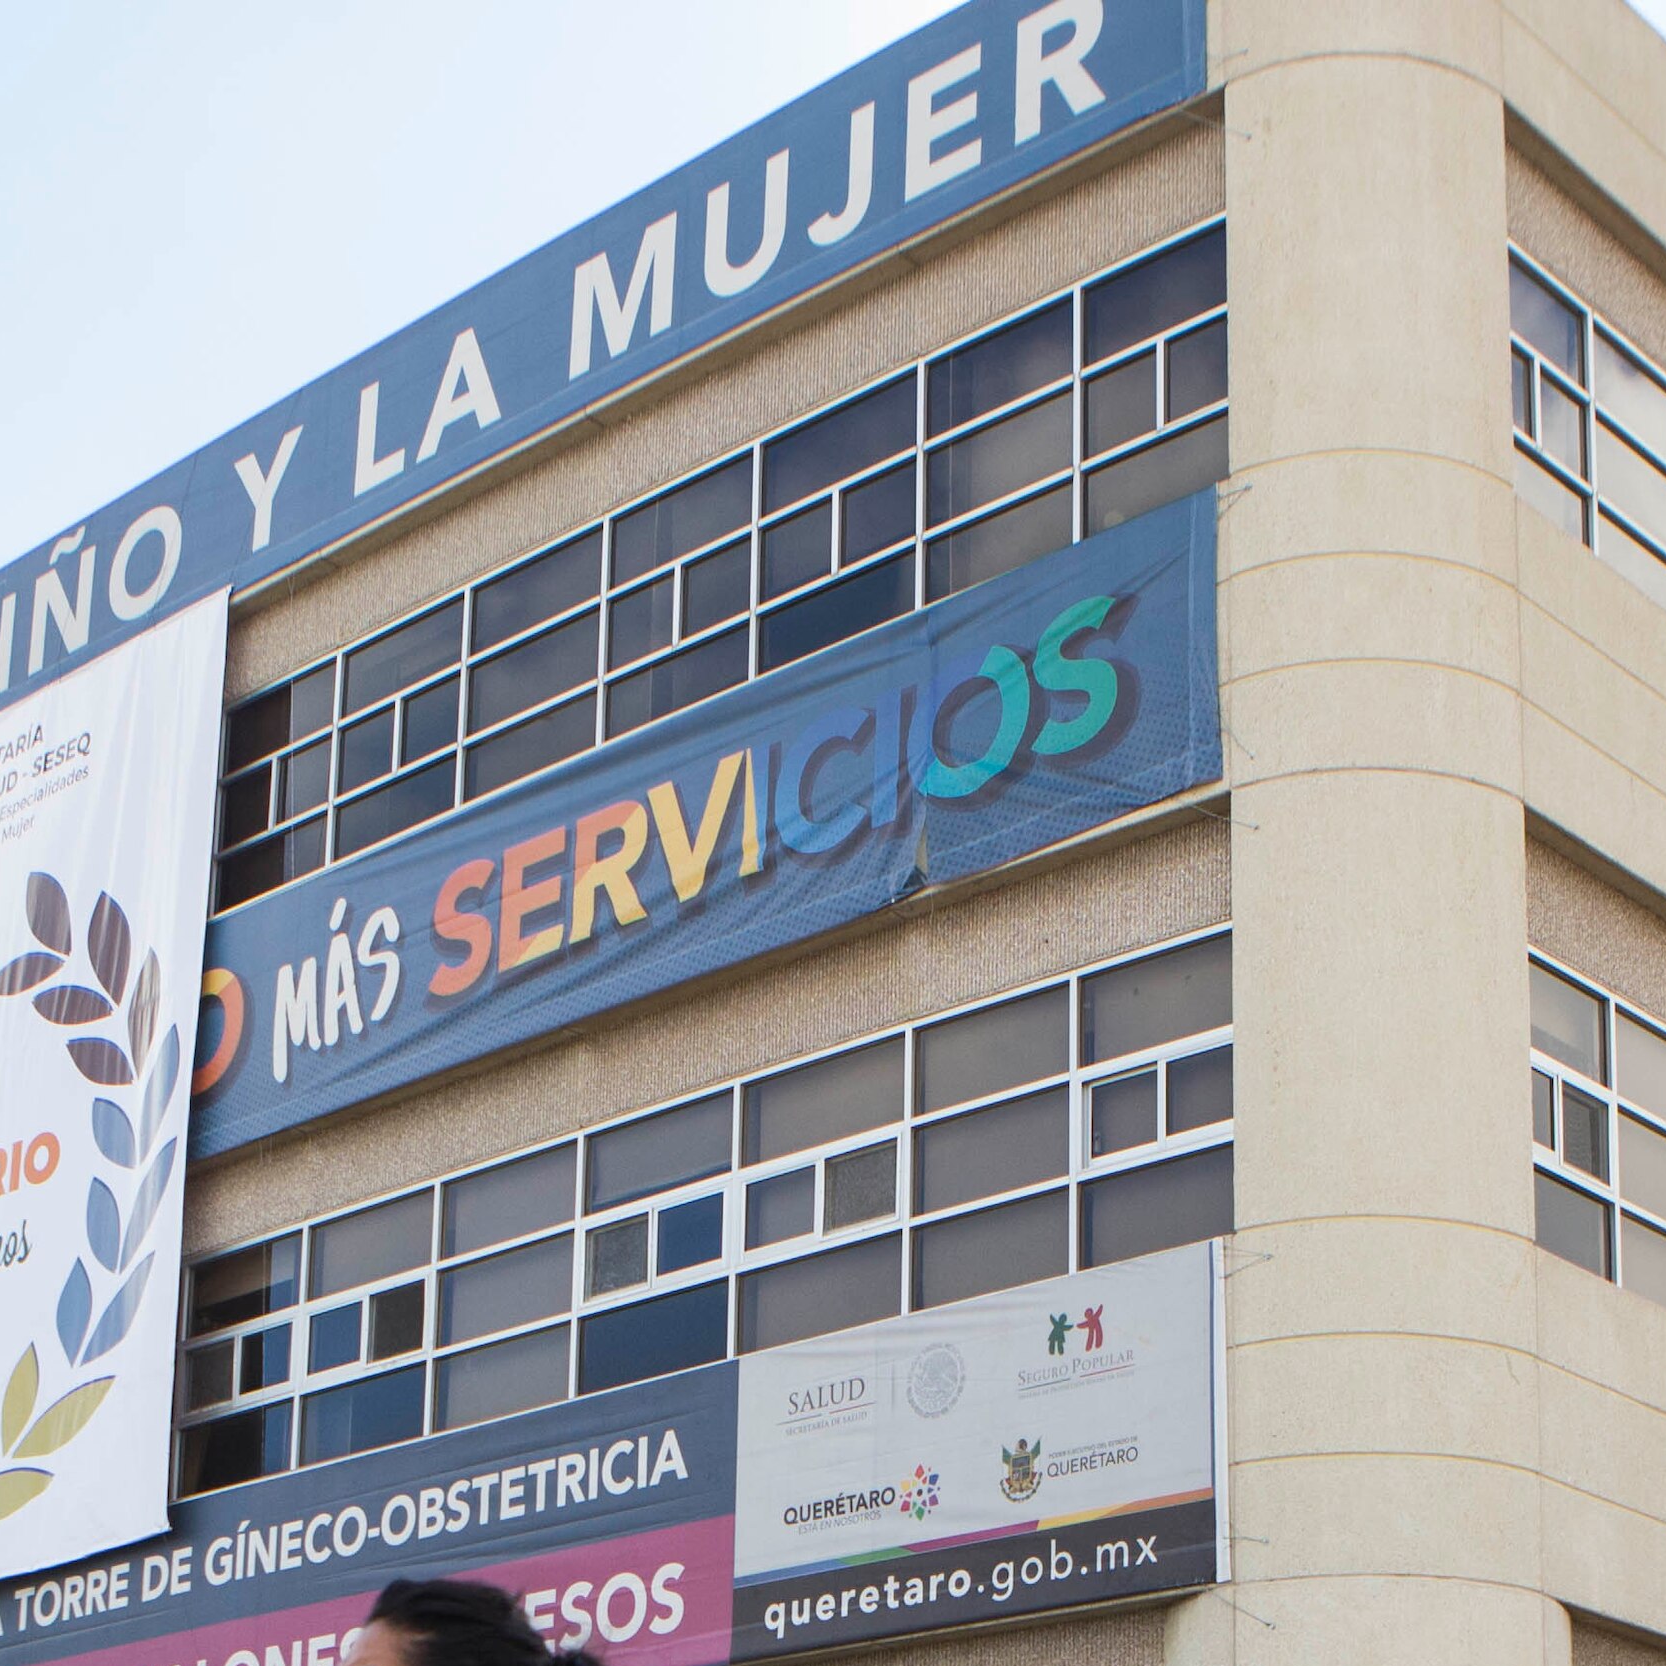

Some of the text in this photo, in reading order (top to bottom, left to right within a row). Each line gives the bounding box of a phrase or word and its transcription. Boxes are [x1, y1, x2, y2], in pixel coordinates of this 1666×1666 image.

[234, 425, 303, 553] Y
[354, 327, 503, 498] LA
[569, 0, 1108, 381] MUJER
[31, 732, 92, 778] SESEQ
[0, 766, 90, 825] Especialidades
[1, 815, 35, 844] Mujer
[272, 897, 401, 1084] MÁS
[429, 594, 1118, 997] SERVICIOS
[788, 1378, 866, 1415] SALUD
[1047, 1446, 1138, 1477] QUERÉTARO
[15, 1562, 132, 1631] TORRE
[142, 1546, 193, 1602] DE
[204, 1428, 689, 1586] GÍNECO-OBSTETRICIA
[783, 1486, 896, 1525] QUERÉTARO
[764, 1535, 1159, 1639] queretaro.gob.mx
